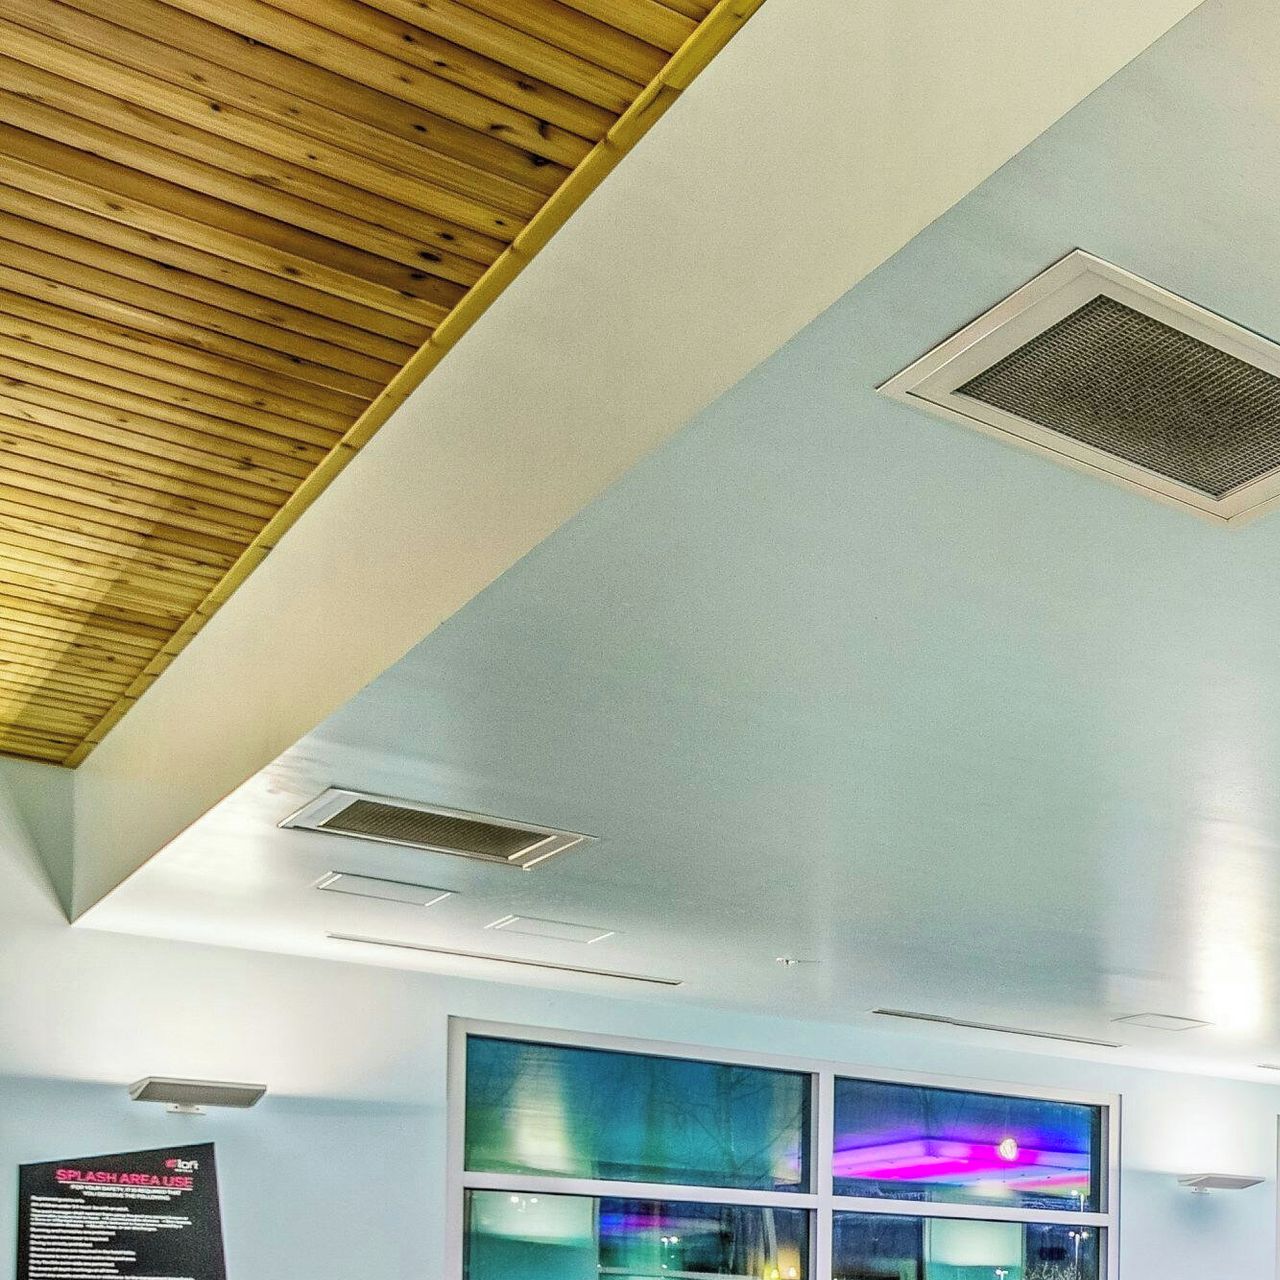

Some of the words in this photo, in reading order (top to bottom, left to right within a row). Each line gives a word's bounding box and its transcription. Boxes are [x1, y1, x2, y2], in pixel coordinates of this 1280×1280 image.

[56, 1169, 118, 1183] SPLASH
[119, 1173, 160, 1186] AREA
[162, 1176, 194, 1188] USE
